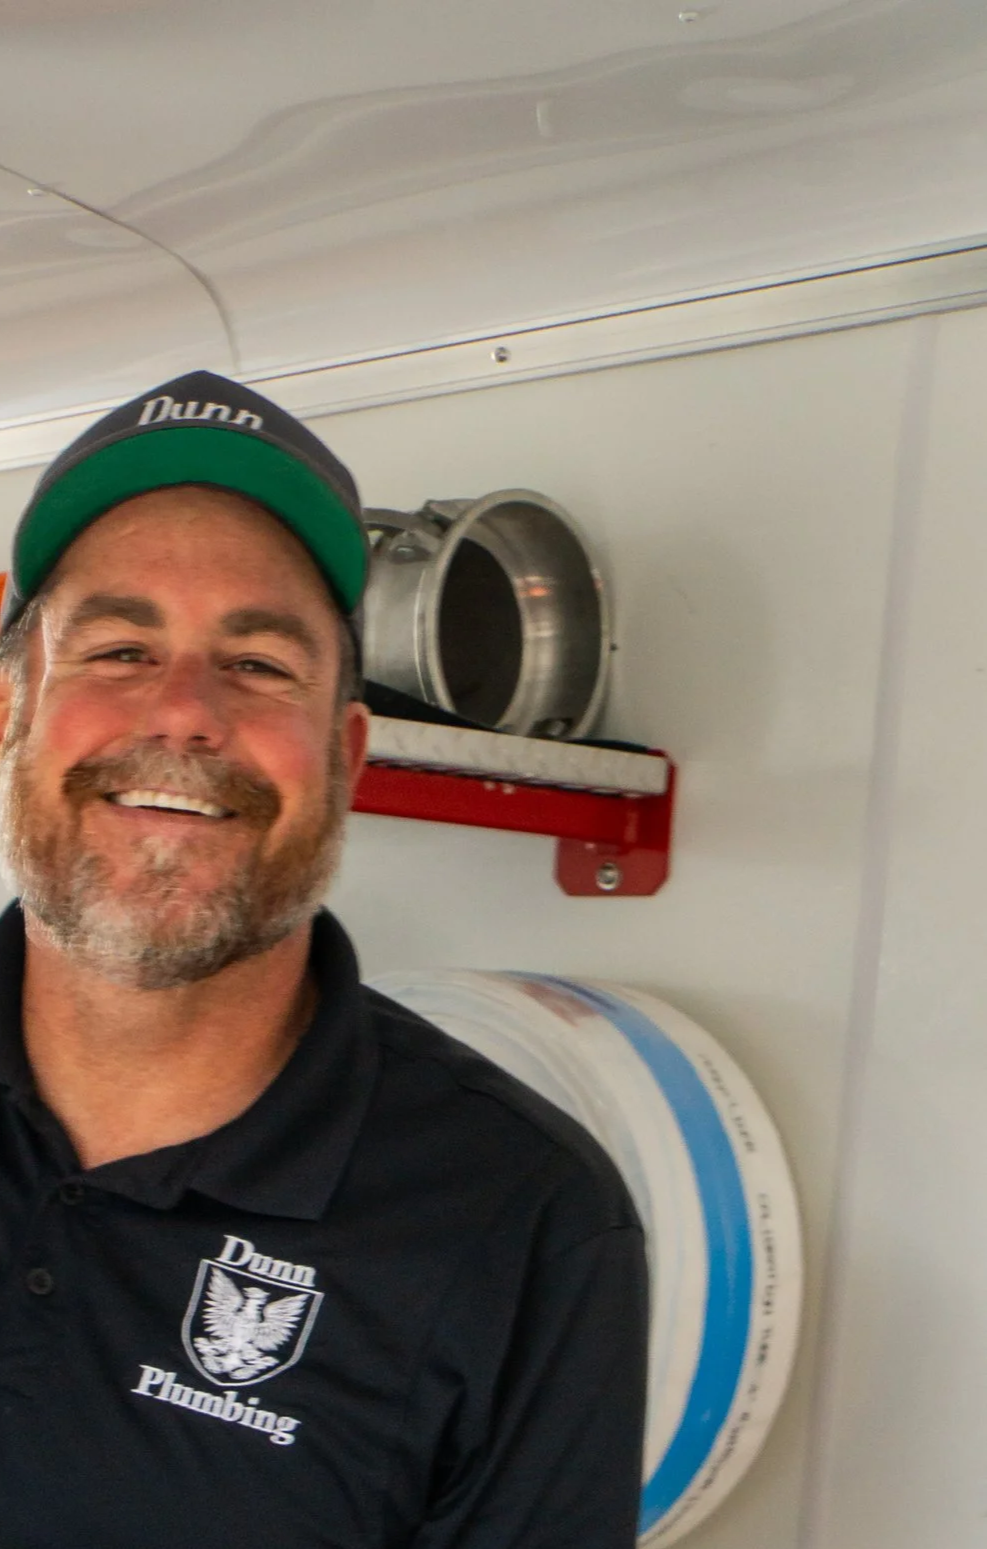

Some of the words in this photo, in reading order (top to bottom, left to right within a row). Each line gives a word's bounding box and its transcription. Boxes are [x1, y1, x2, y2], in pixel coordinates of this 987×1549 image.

[137, 395, 264, 430] Dunn
[215, 1234, 317, 1287] Dunn
[130, 1364, 302, 1446] Plumbing
